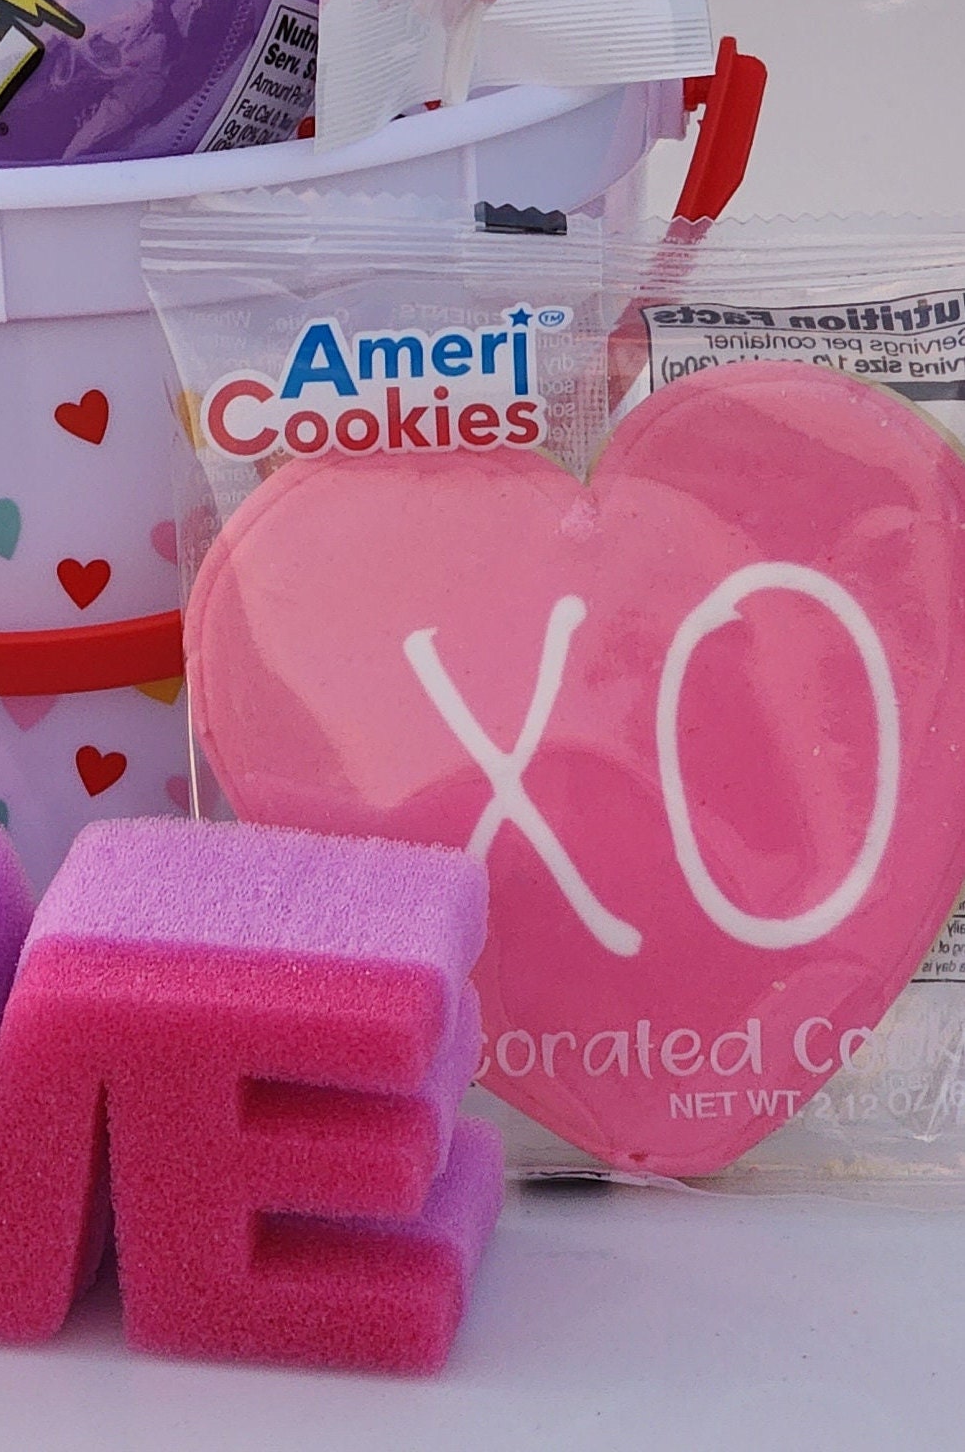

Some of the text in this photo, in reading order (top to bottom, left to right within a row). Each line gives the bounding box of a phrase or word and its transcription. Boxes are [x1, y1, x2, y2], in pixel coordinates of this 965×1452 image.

[264, 43, 301, 76] Serv.
[280, 308, 531, 400] Ameri
[207, 386, 540, 457] Cookies
[403, 561, 900, 959] XO
[669, 1091, 738, 1119] NET
